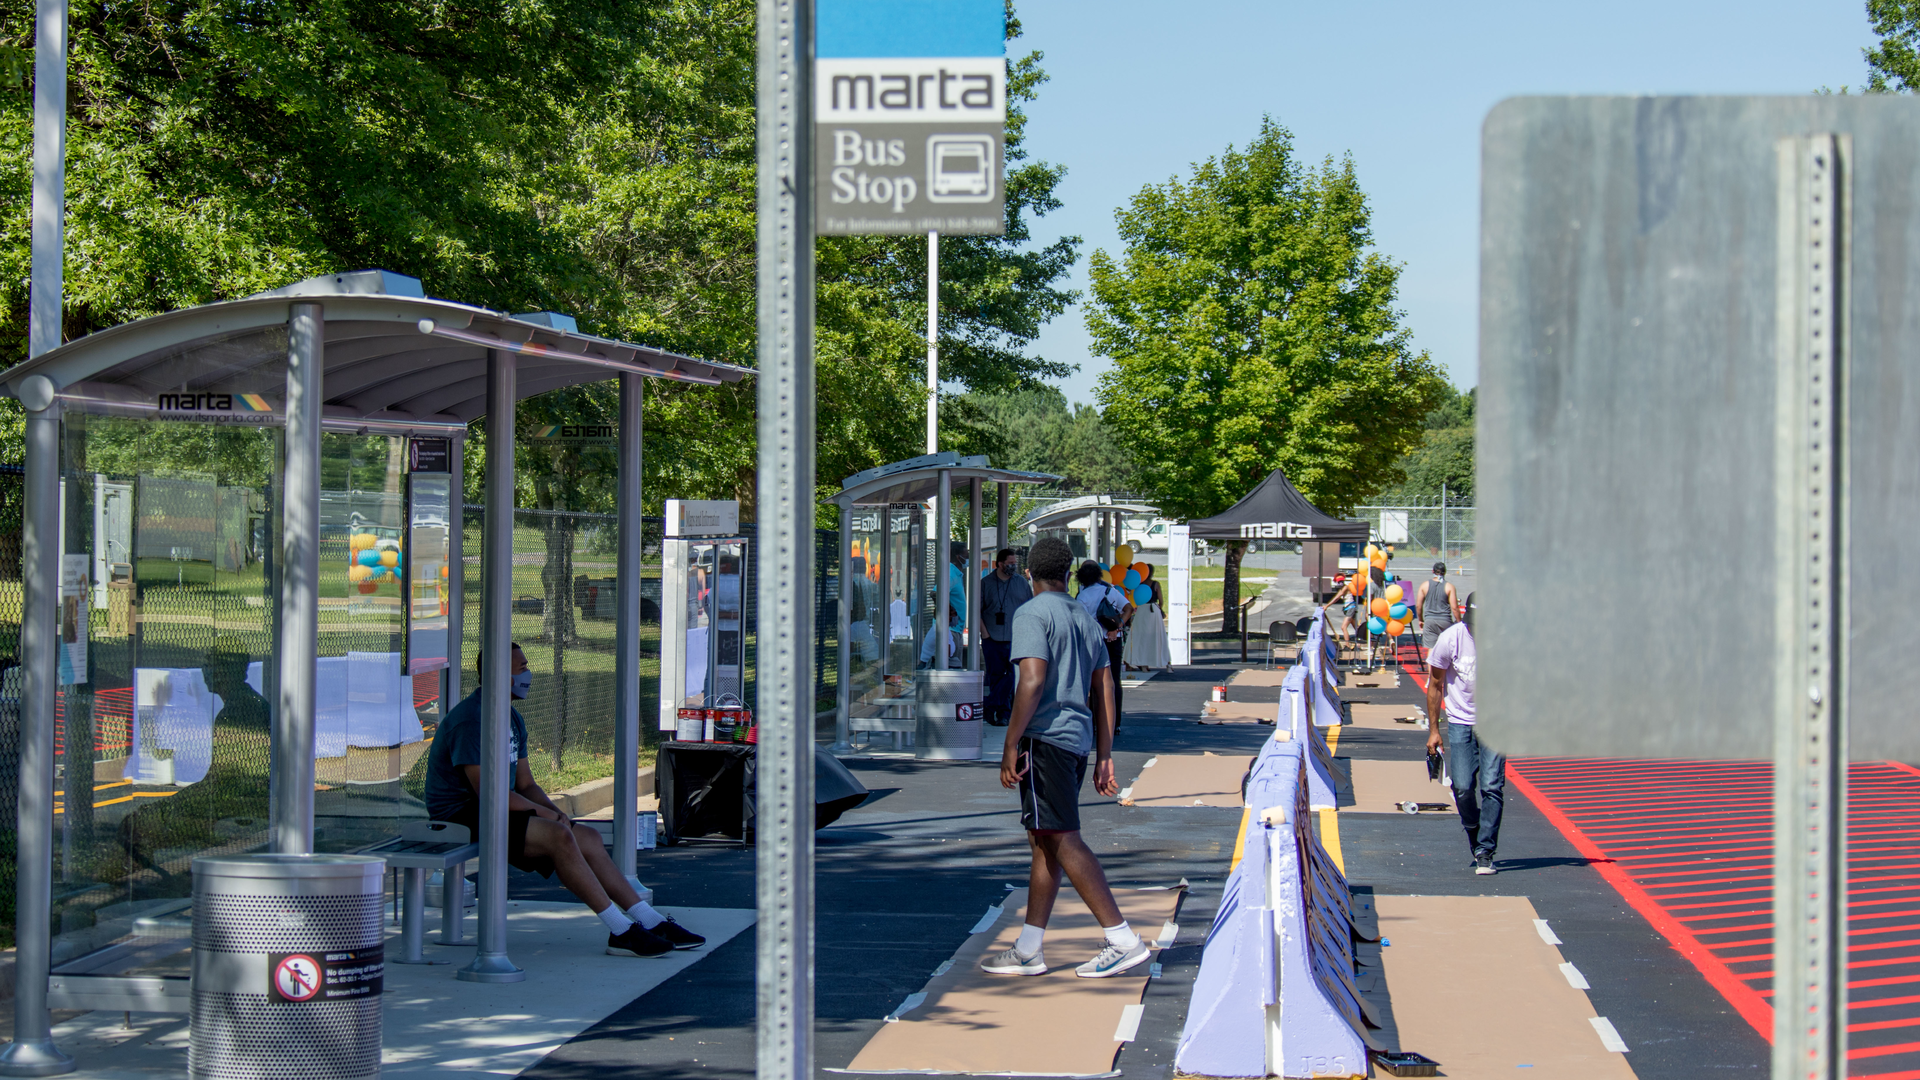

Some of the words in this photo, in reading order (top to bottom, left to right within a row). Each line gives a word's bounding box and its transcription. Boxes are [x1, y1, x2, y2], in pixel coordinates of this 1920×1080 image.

[832, 69, 993, 109] marta
[833, 130, 905, 166] Bus
[831, 167, 917, 213] Stop
[159, 392, 232, 410] marta
[159, 411, 274, 423] www.itsmarta.com
[889, 502, 917, 510] marta
[1241, 522, 1312, 538] marta
[326, 953, 347, 961] marta
[326, 969, 337, 977] No
[337, 968, 363, 977] dumping
